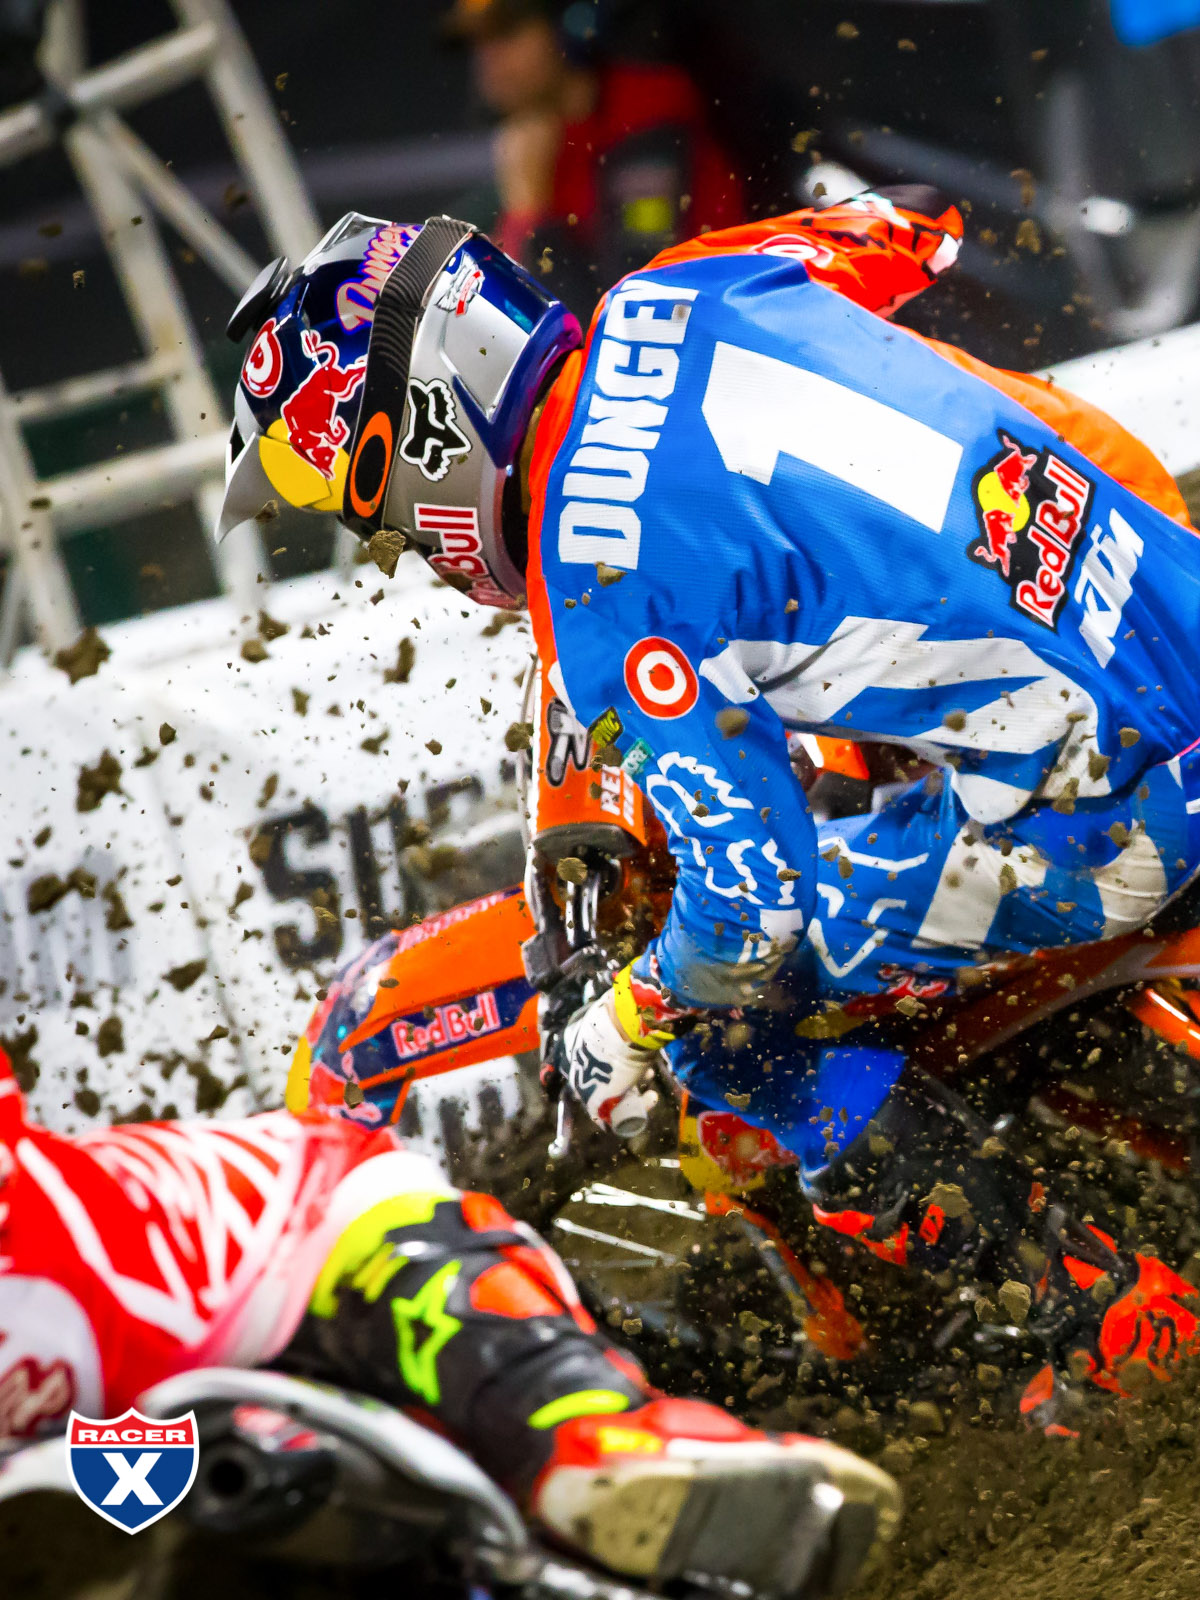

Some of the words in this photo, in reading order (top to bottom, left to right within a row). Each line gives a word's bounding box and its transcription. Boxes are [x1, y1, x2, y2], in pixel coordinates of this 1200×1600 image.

[558, 279, 699, 570] DUNGEY
[701, 341, 964, 533] 1
[1036, 454, 1090, 550] Bull
[1017, 523, 1071, 628] Red
[1074, 507, 1144, 669] KTM
[391, 1007, 447, 1059] Red
[446, 991, 501, 1038] Bull
